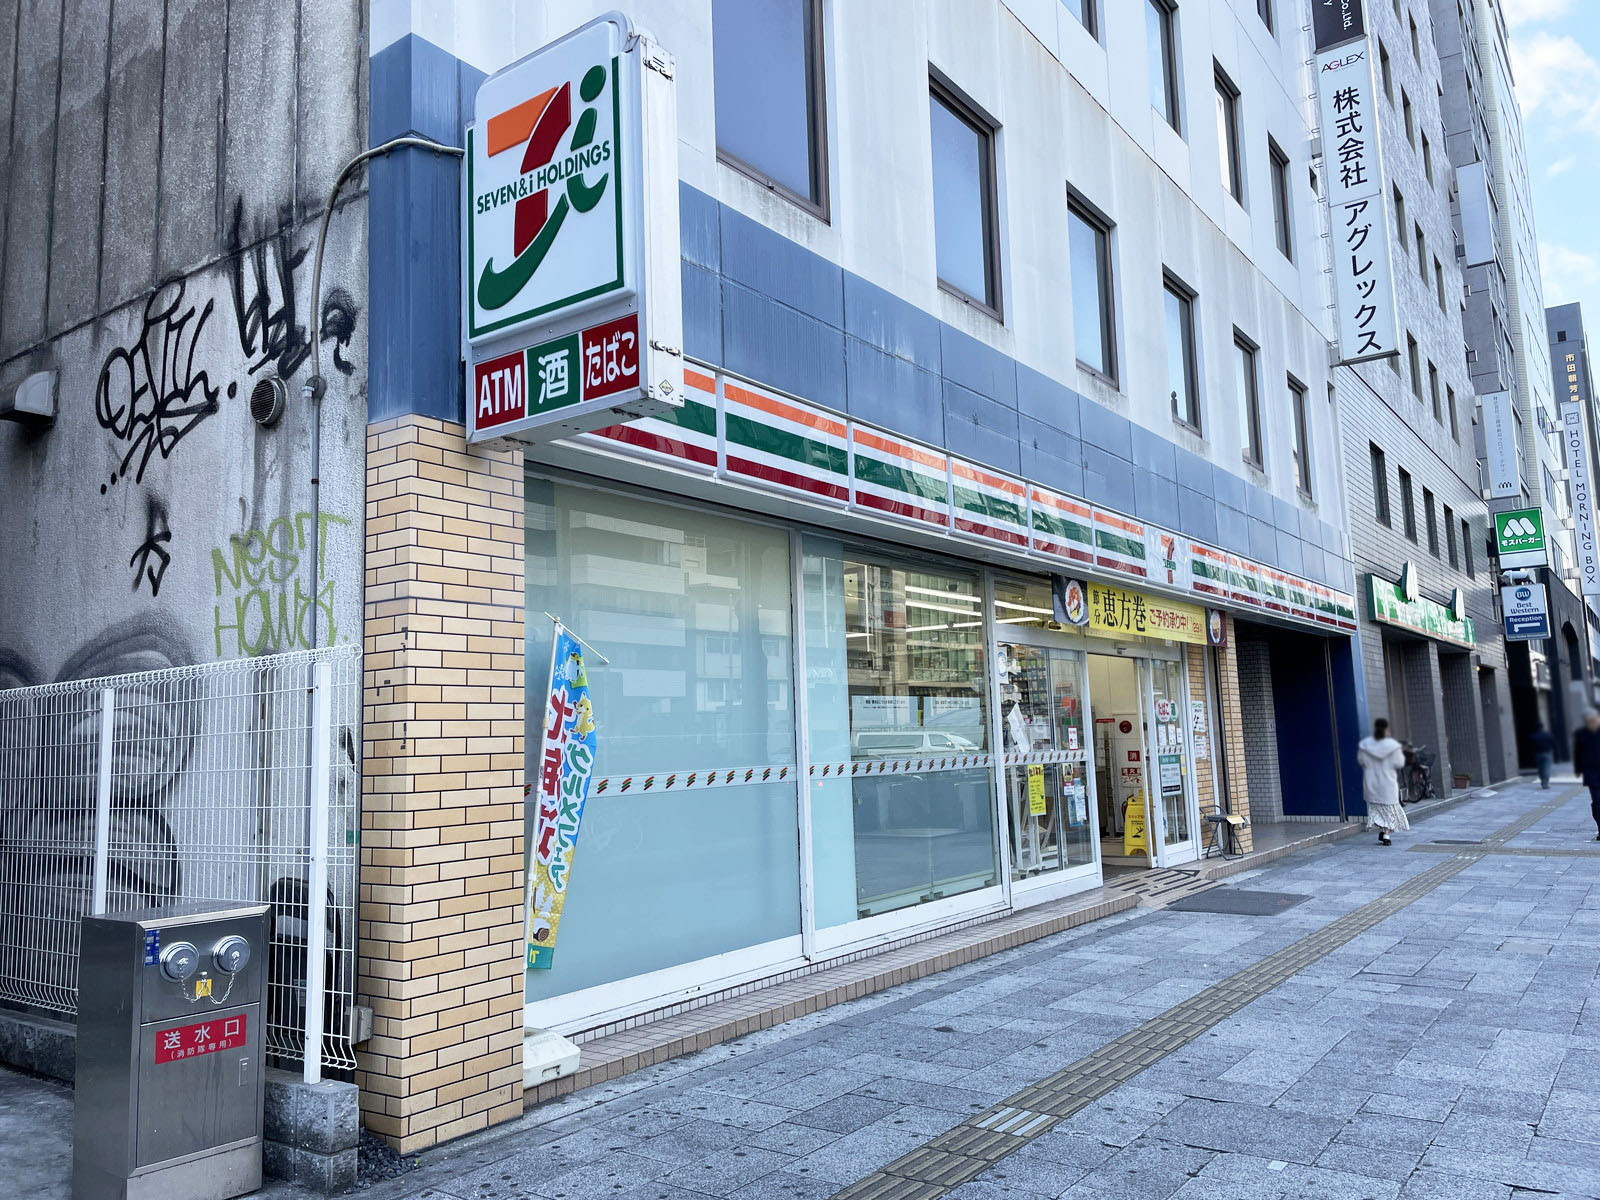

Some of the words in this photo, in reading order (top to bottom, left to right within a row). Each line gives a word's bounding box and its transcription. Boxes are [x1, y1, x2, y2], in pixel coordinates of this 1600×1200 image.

[1321, 51, 1364, 73] AGLEX
[537, 140, 611, 188] HOLDINGS
[537, 348, 570, 405] 酒
[585, 329, 637, 390] たばこ
[479, 364, 522, 419] ATM
[1569, 429, 1583, 478] HOTEL
[1575, 482, 1593, 551] MORNING
[1501, 536, 1542, 547] モスバーガー
[1585, 555, 1596, 584] BOX
[1101, 589, 1147, 632] 恵方巻
[1510, 607, 1540, 615] Western
[1516, 590, 1530, 599] BW
[1509, 615, 1543, 623] Reception
[163, 1019, 240, 1050] 送水口
